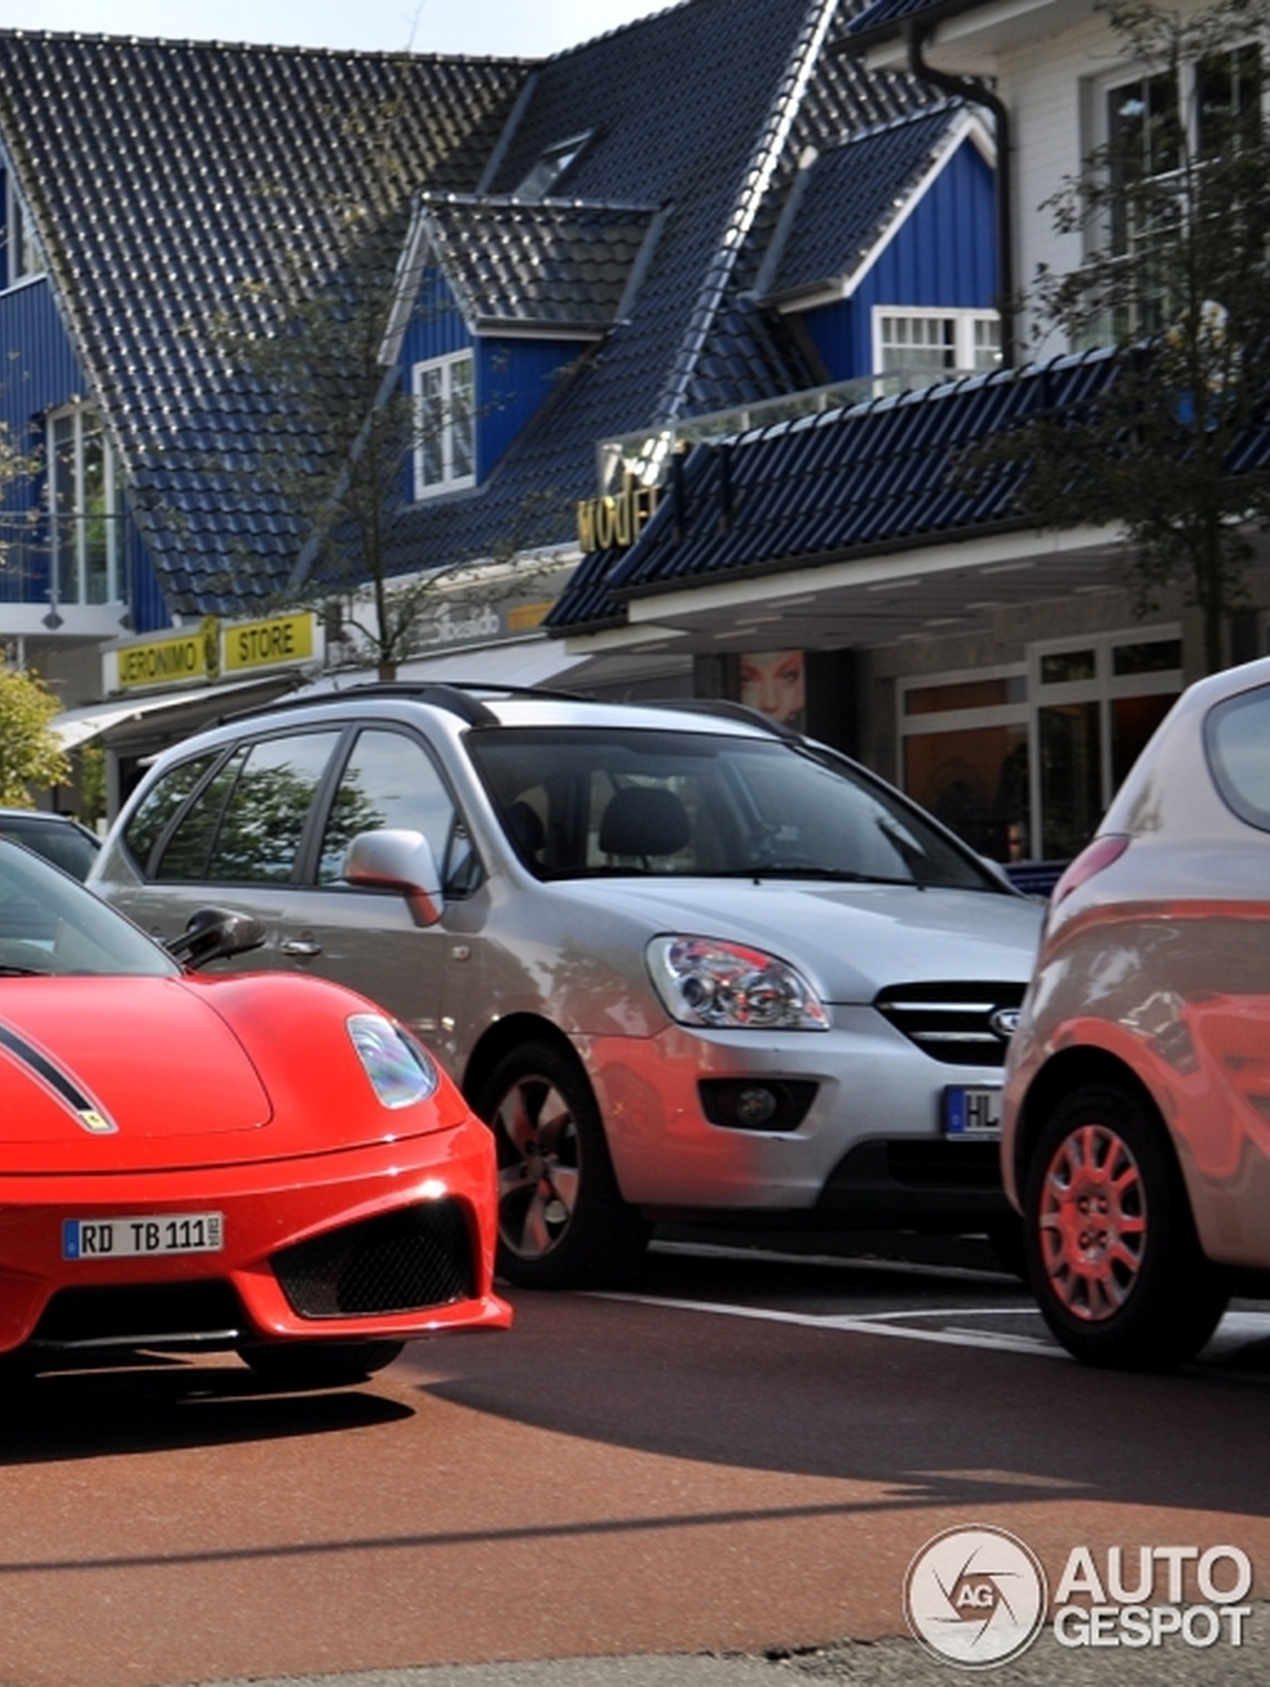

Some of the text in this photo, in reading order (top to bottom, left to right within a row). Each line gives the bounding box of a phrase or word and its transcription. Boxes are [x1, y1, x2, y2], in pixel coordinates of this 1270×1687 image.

[238, 623, 294, 661] STORE
[966, 1094, 999, 1128] HL
[82, 1225, 113, 1254] RD
[131, 1222, 160, 1251] TB
[166, 1219, 206, 1249] 111
